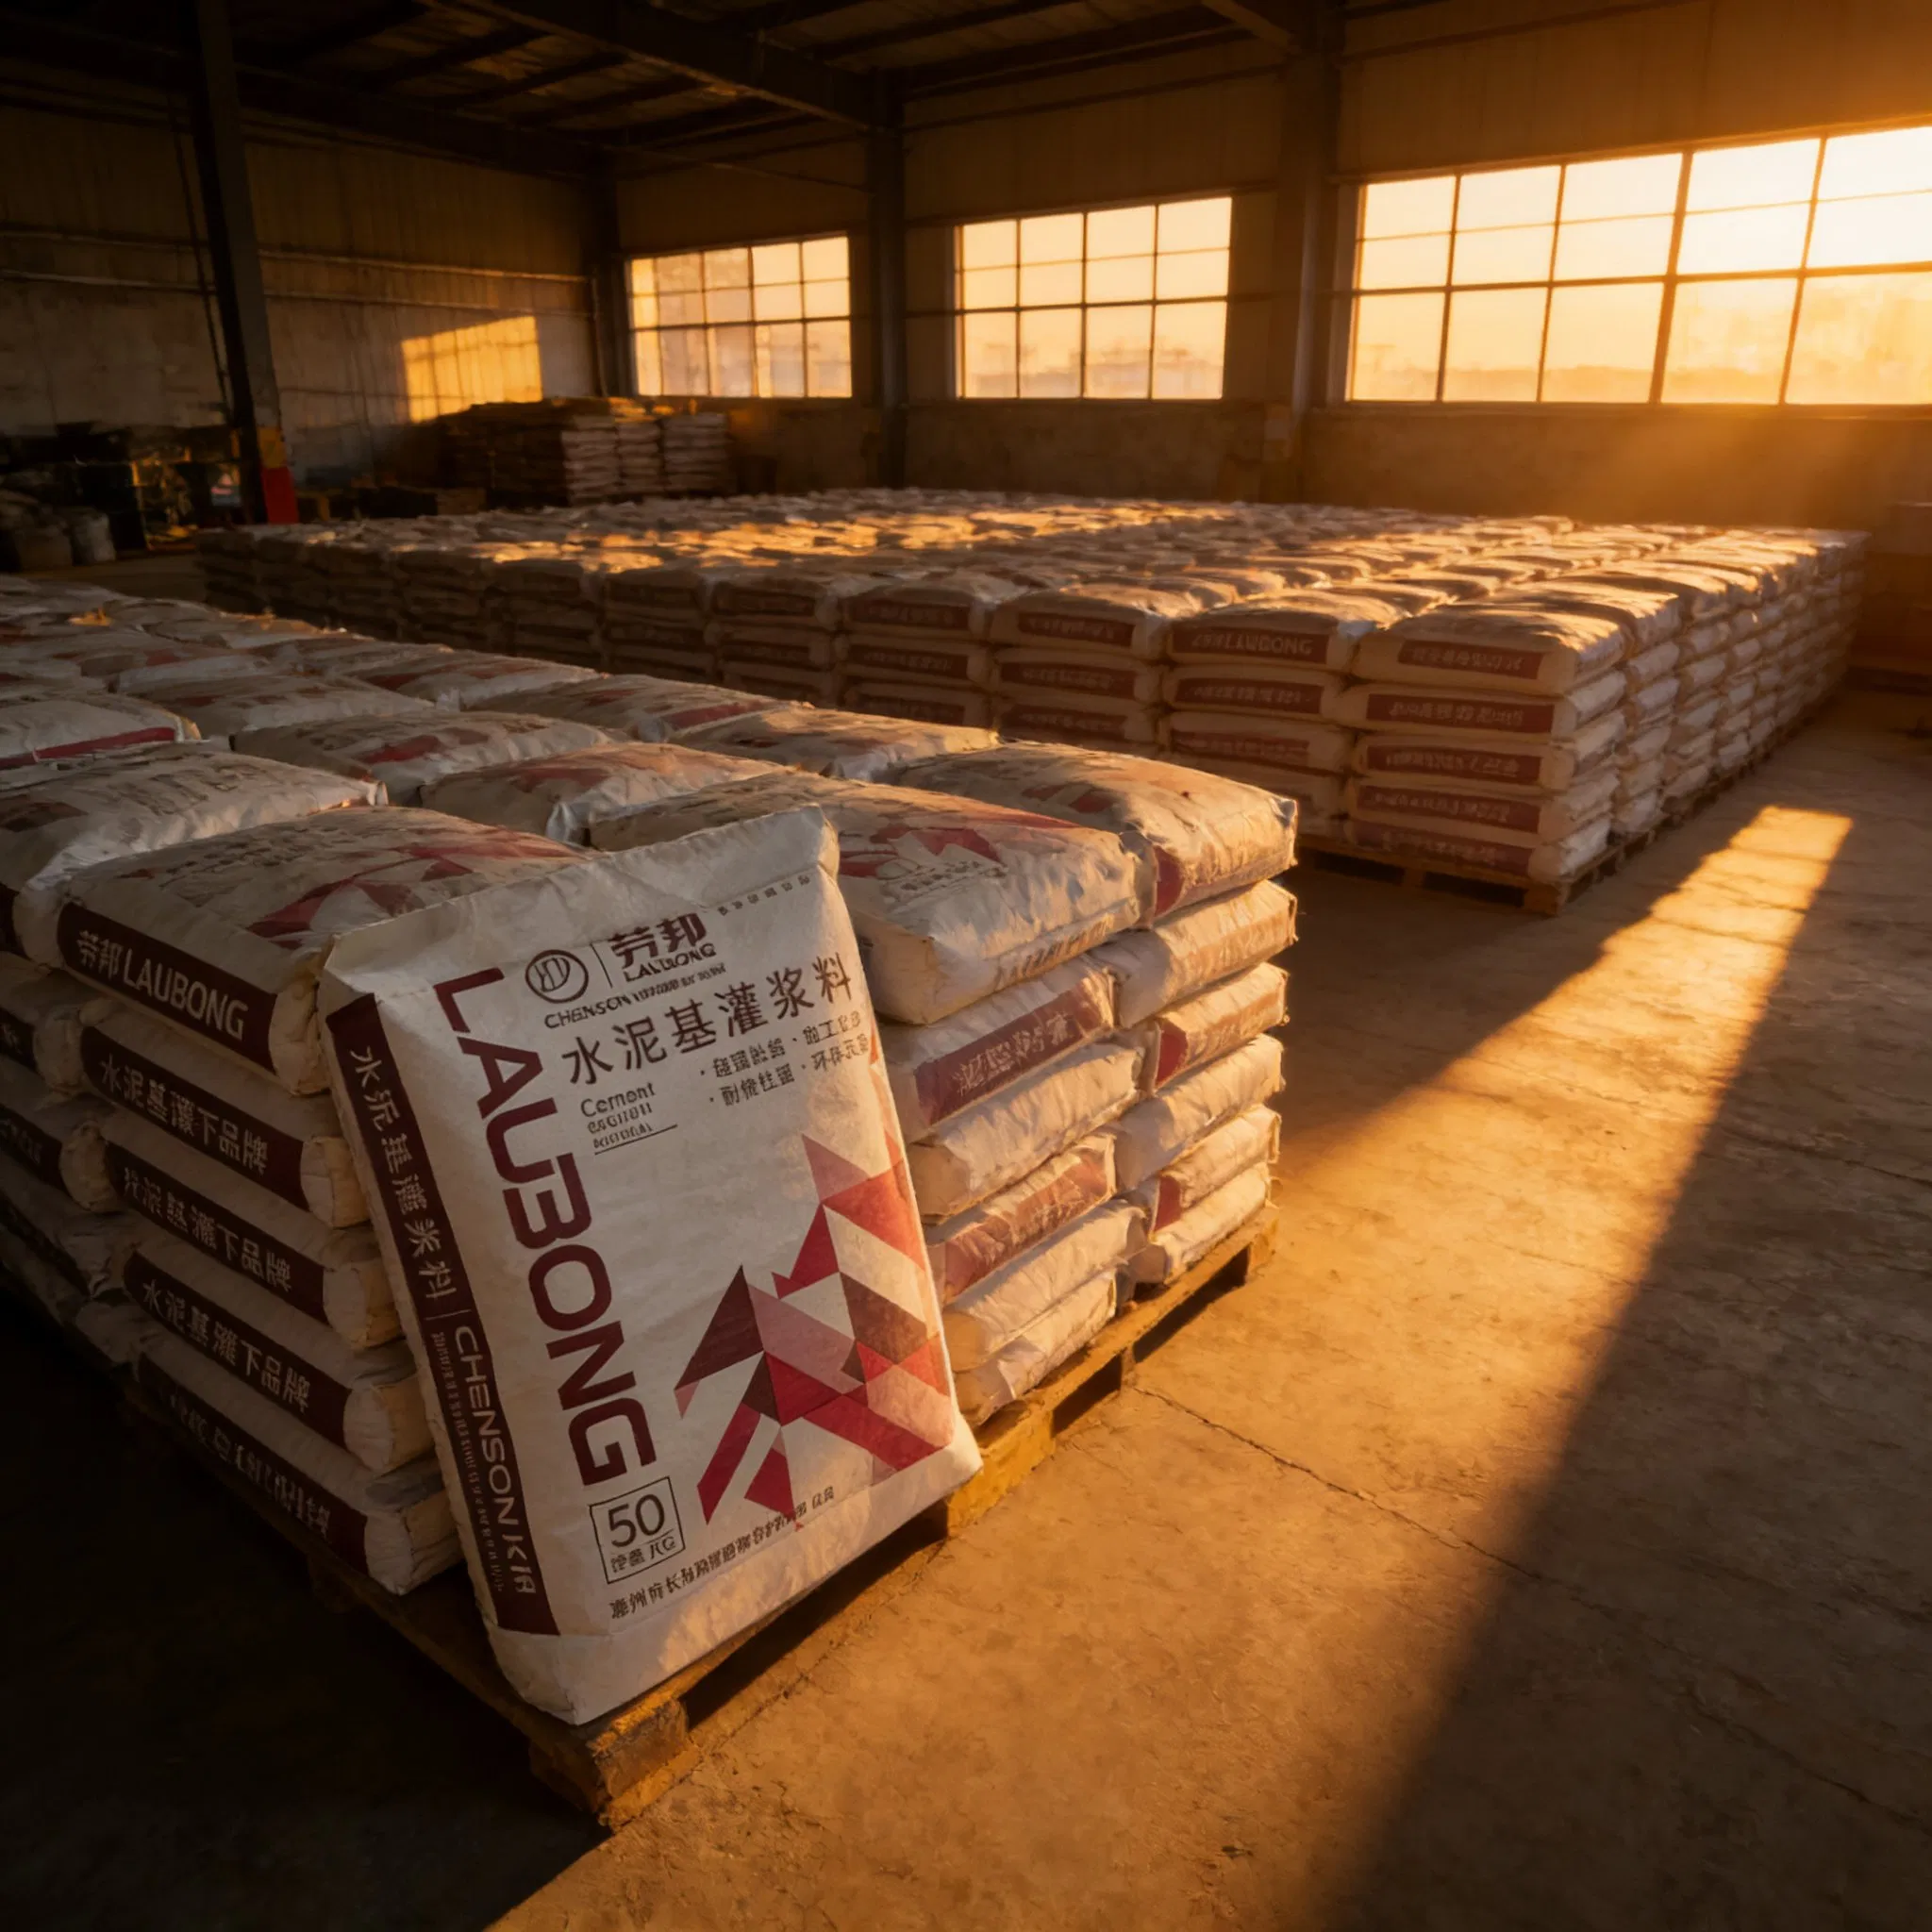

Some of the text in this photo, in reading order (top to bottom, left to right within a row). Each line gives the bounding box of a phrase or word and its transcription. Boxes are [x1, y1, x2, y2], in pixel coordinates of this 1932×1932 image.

[124, 947, 250, 1041] LAUBONG
[560, 952, 852, 1087] 水泥基灌浆料
[433, 967, 658, 1487] LAUBONG
[453, 1324, 519, 1526] CHENSON
[608, 1493, 665, 1548] 50
